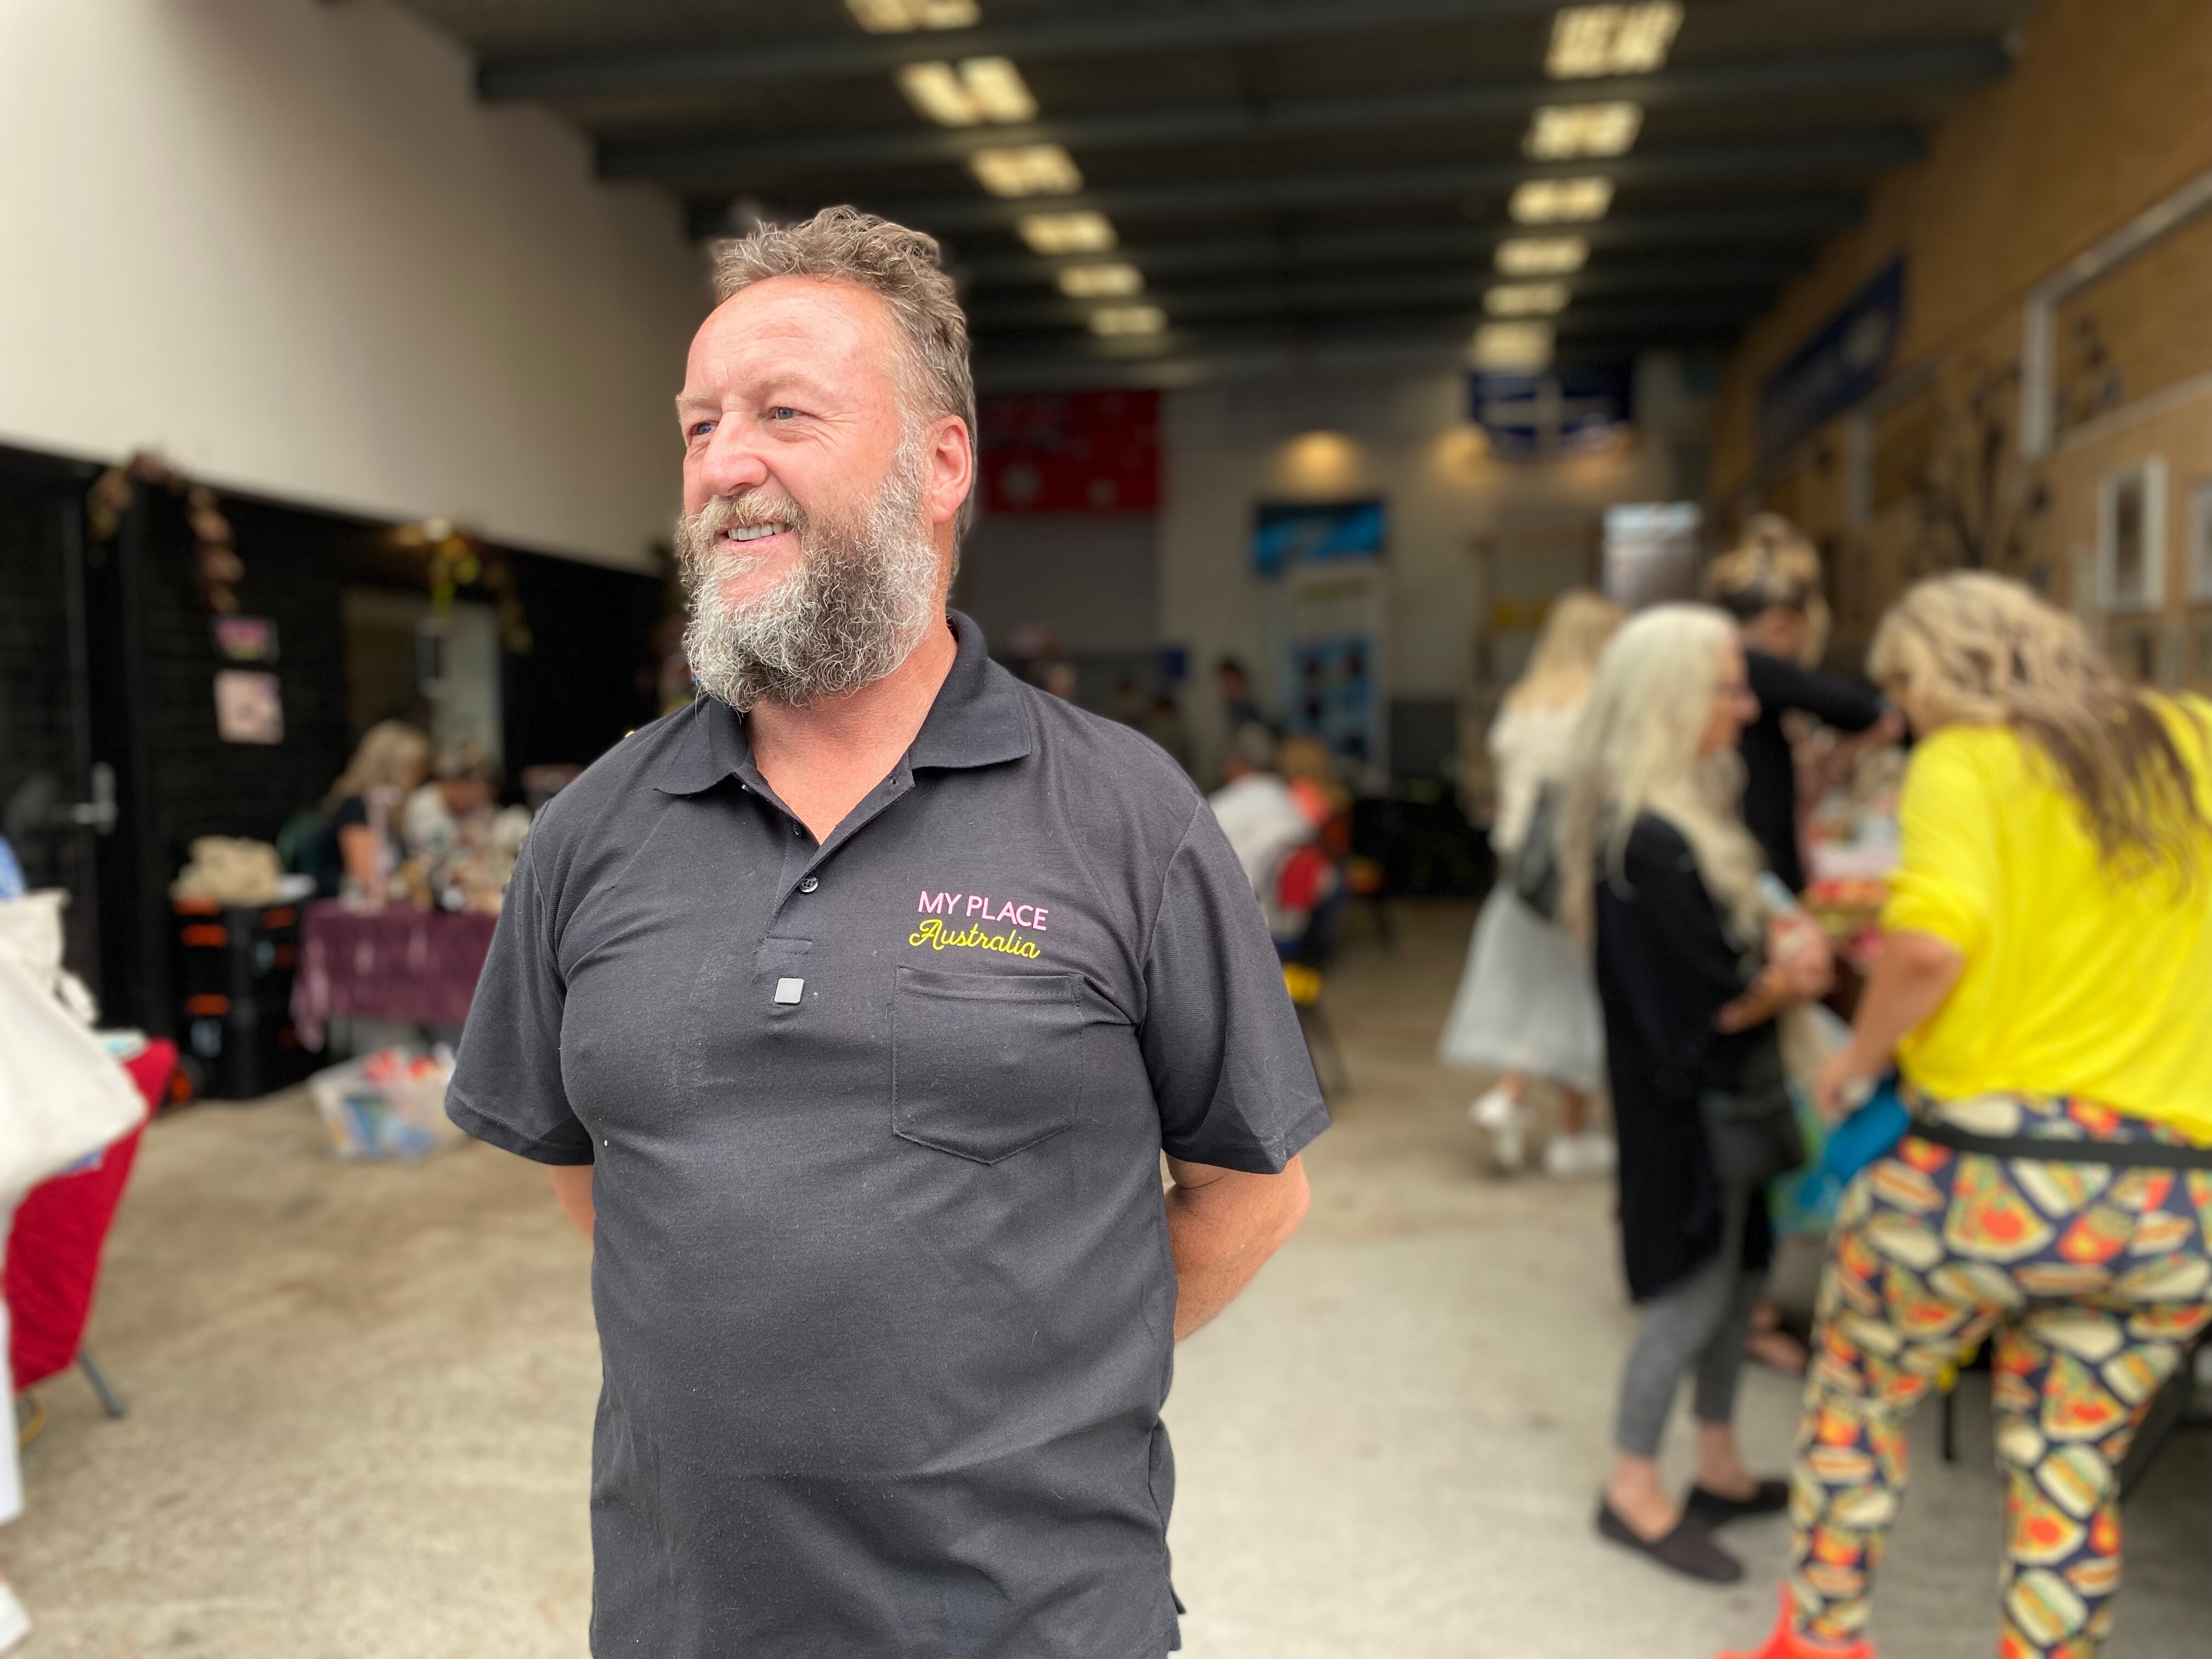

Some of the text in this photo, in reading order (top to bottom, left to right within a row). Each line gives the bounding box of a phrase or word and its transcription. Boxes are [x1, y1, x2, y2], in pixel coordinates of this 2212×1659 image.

[918, 891, 1048, 930] MY PLACE
[909, 919, 1041, 958] Australia
